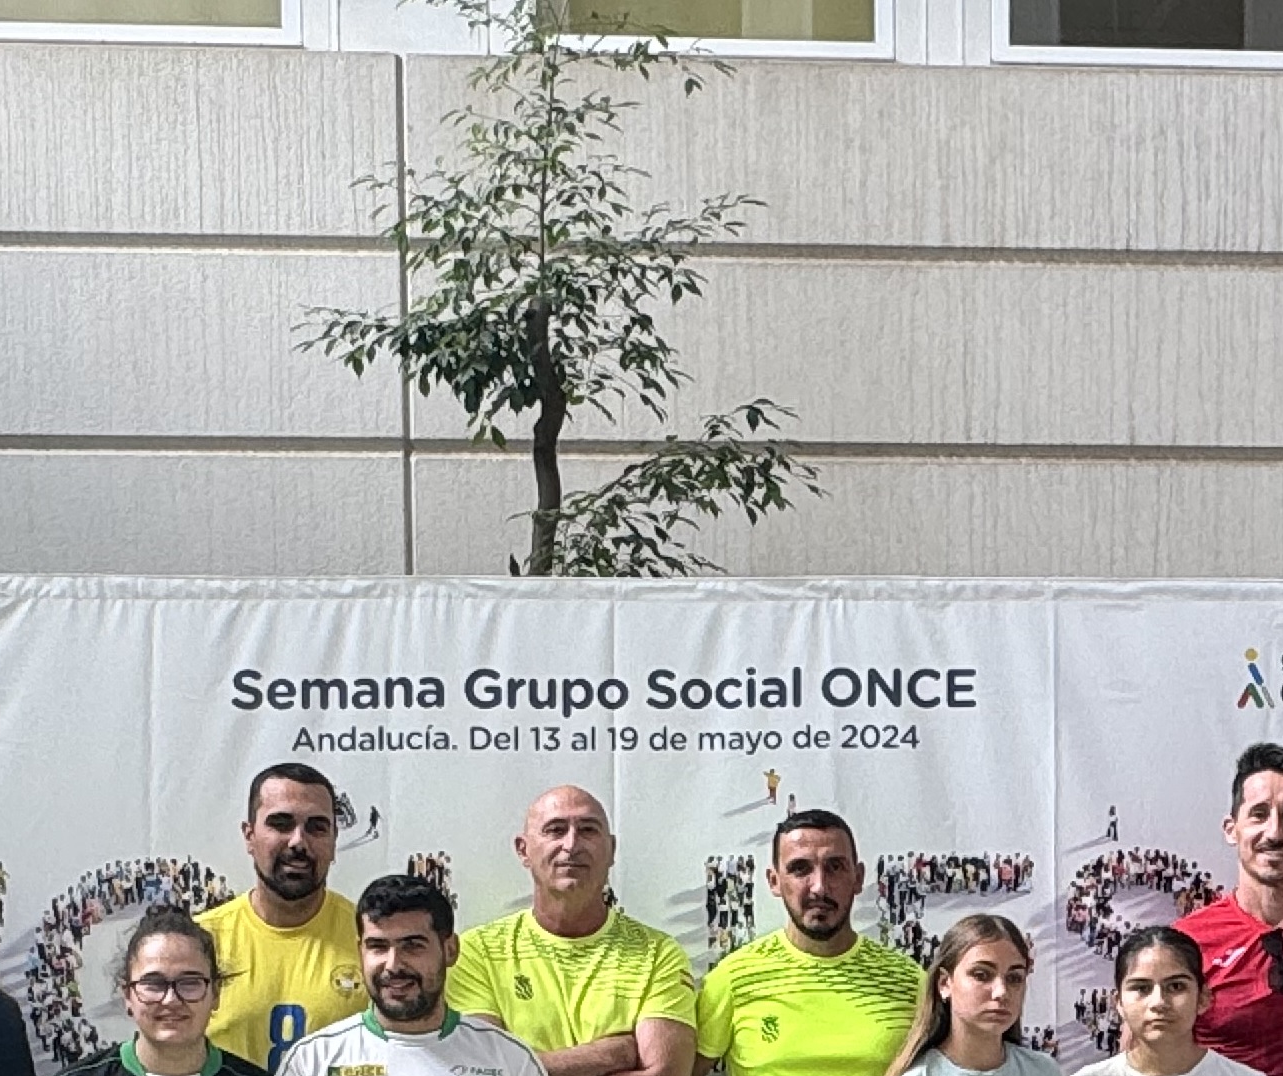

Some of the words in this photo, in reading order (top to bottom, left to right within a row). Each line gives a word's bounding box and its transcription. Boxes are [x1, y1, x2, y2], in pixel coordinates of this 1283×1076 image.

[231, 668, 445, 710] Semana
[464, 668, 629, 718] Grupo
[646, 666, 802, 710] Social
[821, 667, 977, 709] ONCE
[291, 724, 458, 752] Andalucía.
[469, 726, 519, 752] Del
[530, 726, 561, 752] 13
[571, 726, 596, 752] al
[607, 726, 639, 752] 19
[649, 725, 687, 752] de
[698, 730, 783, 757] mayo
[792, 724, 831, 750] de
[841, 724, 921, 749] 2024
